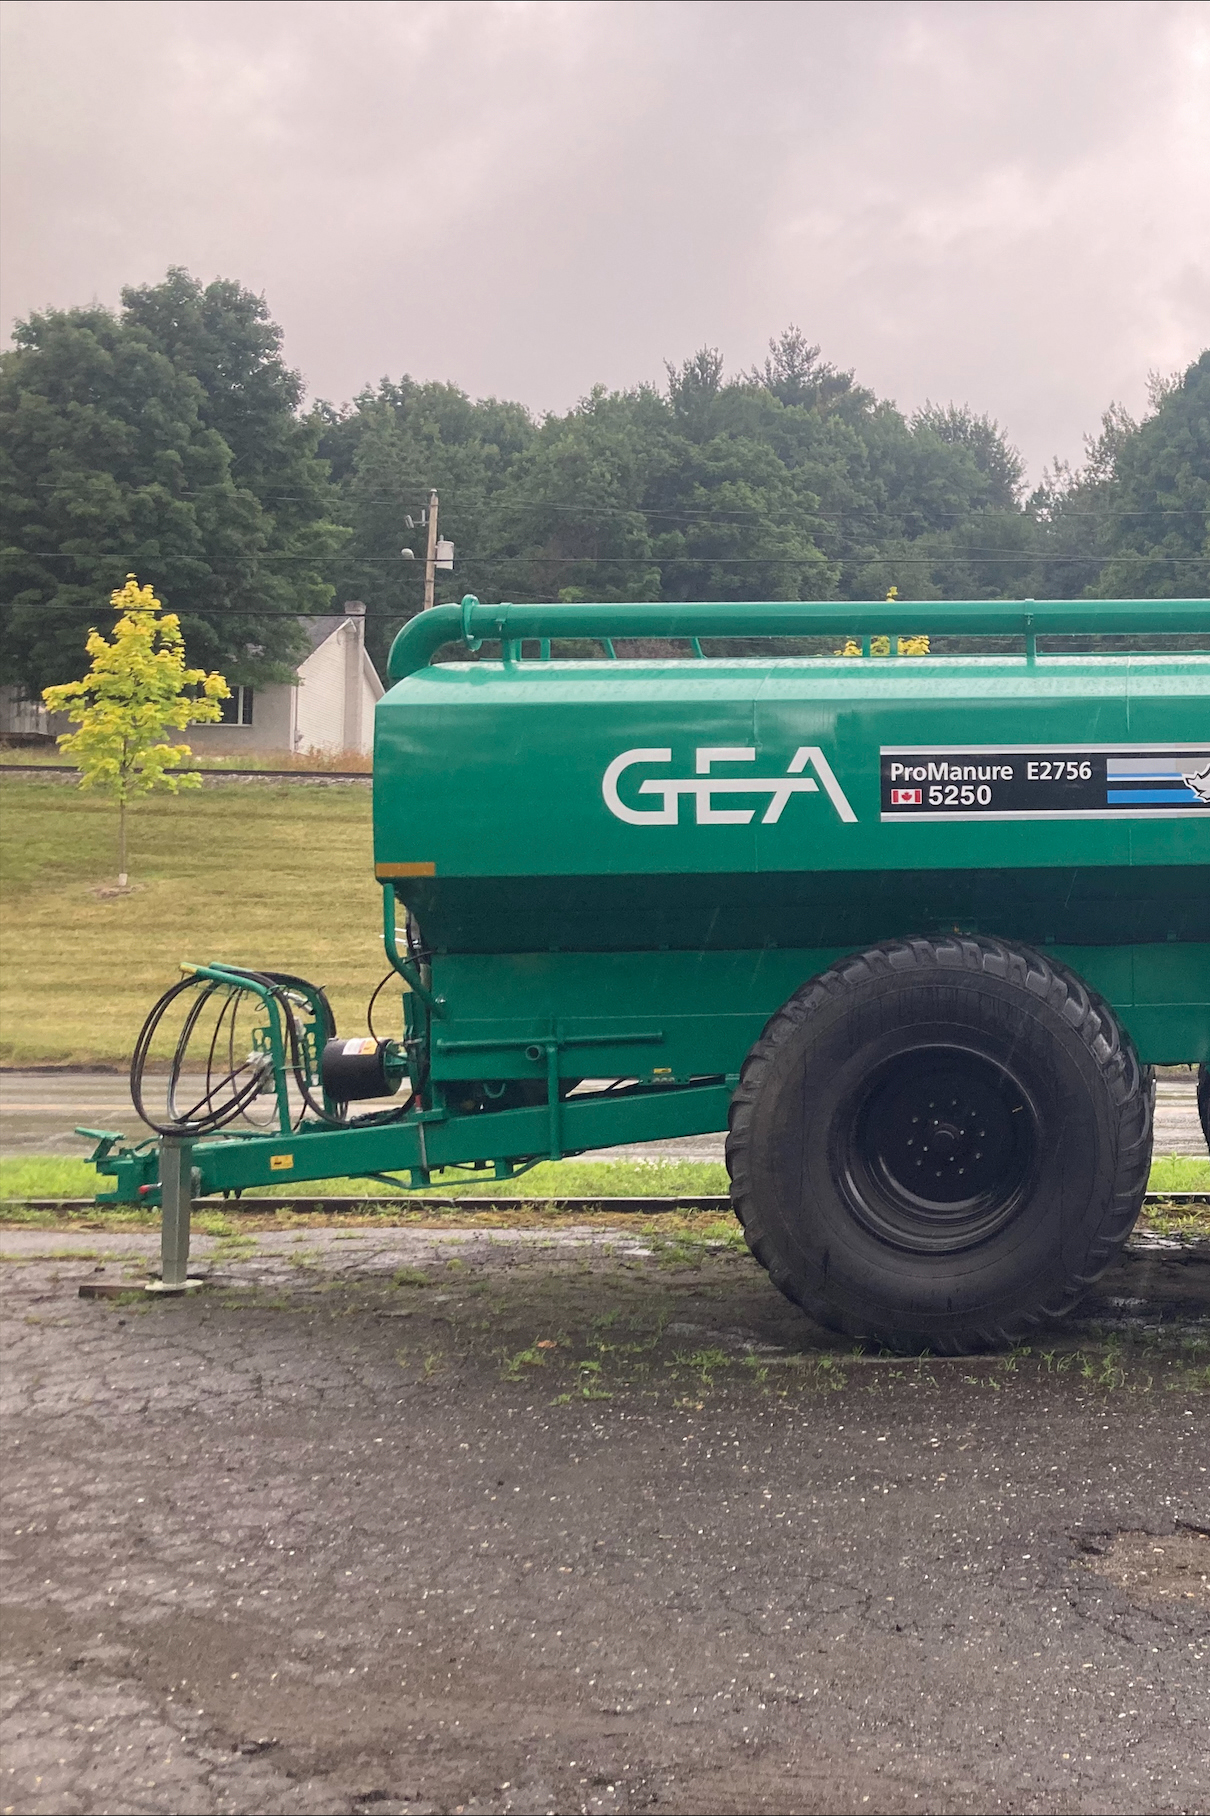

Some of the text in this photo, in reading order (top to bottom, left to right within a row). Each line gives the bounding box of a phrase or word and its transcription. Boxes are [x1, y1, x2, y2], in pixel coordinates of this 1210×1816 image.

[890, 761, 1092, 782] ProManure E2756
[602, 746, 858, 826] GEA
[928, 785, 992, 806] 5250
